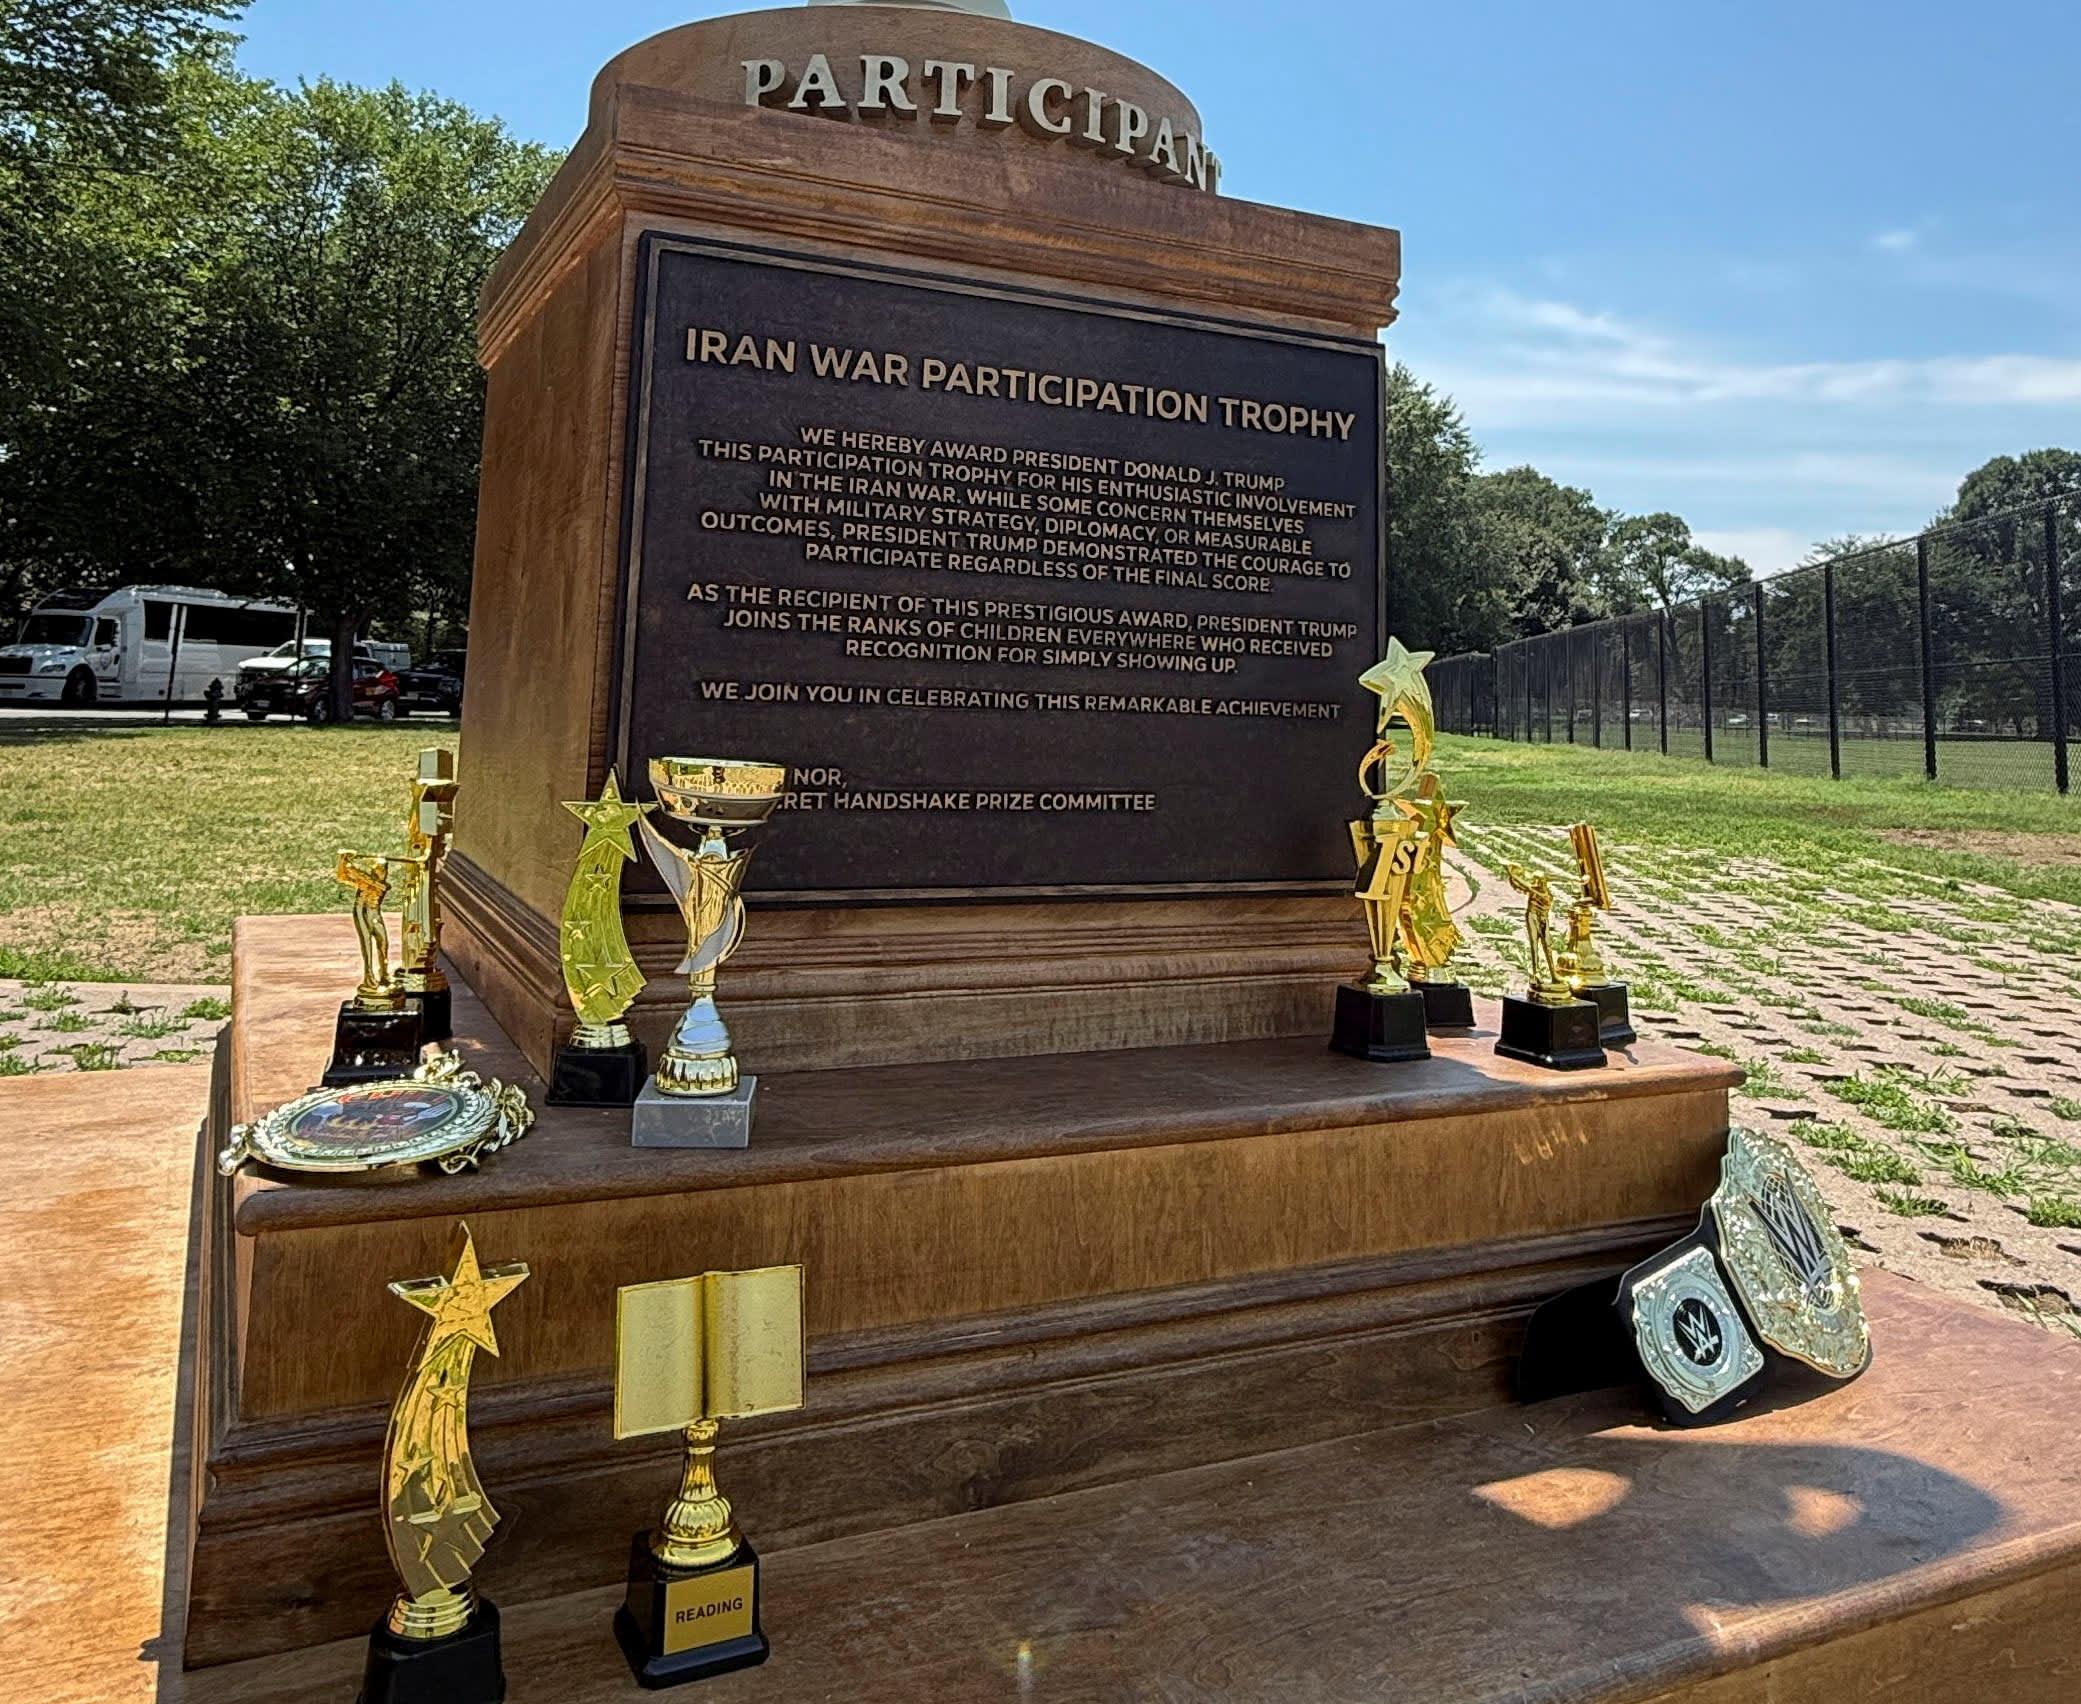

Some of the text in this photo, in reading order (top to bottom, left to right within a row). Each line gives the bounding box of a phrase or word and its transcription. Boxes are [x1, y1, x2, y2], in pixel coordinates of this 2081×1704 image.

[686, 328, 1356, 441] IRAN WAR PARTICIPATION TROPHY
[698, 439, 1356, 519] THIS PARTICIPATION TROPHY FOR HIS ENTHUSIASTIC INVOLVEMENT
[800, 427, 1285, 492] WE HEREBY AWARD PRESIDENT DONALD J. TRUMP
[759, 492, 1313, 557] WITH MILITARY STRATEGY, DIPLOMACY, OR MEASURABLE
[769, 470, 1305, 535] IN THE IRAN WAR. WHILE SOME CONCERN THEMSELVES
[700, 511, 1352, 580] OUTCOMES, PRESIDENT TRUMP DEMONSTRATED THE COURAGE TO
[805, 543, 943, 569] PARTICIPATE
[947, 552, 1078, 579] REGARDLESS
[1081, 563, 1109, 581] OF
[1113, 565, 1150, 584] THE
[1155, 568, 1208, 588] FINAL
[687, 583, 1357, 640] AS THE RECIPIENT OF THIS PRESTIGIOUS AWARD, PRESIDENT TRUMP
[723, 609, 1333, 657] JOINS THE RANKS OF CHILDREN EVERYWHERE WHO RECEIVED
[846, 639, 1238, 674] RECOGNITION FOR SIMPLY SHOWING UP.
[701, 682, 1340, 720] WE JOIN YOU IN CELEBRATING THIS REMARKABLE ACHIEVEMENT
[776, 792, 1156, 812] RET HANDSHAKE PRIZE COMMITTEE
[793, 767, 848, 790] NOR,
[1354, 832, 1431, 901] 1st
[676, 1597, 743, 1624] READING
